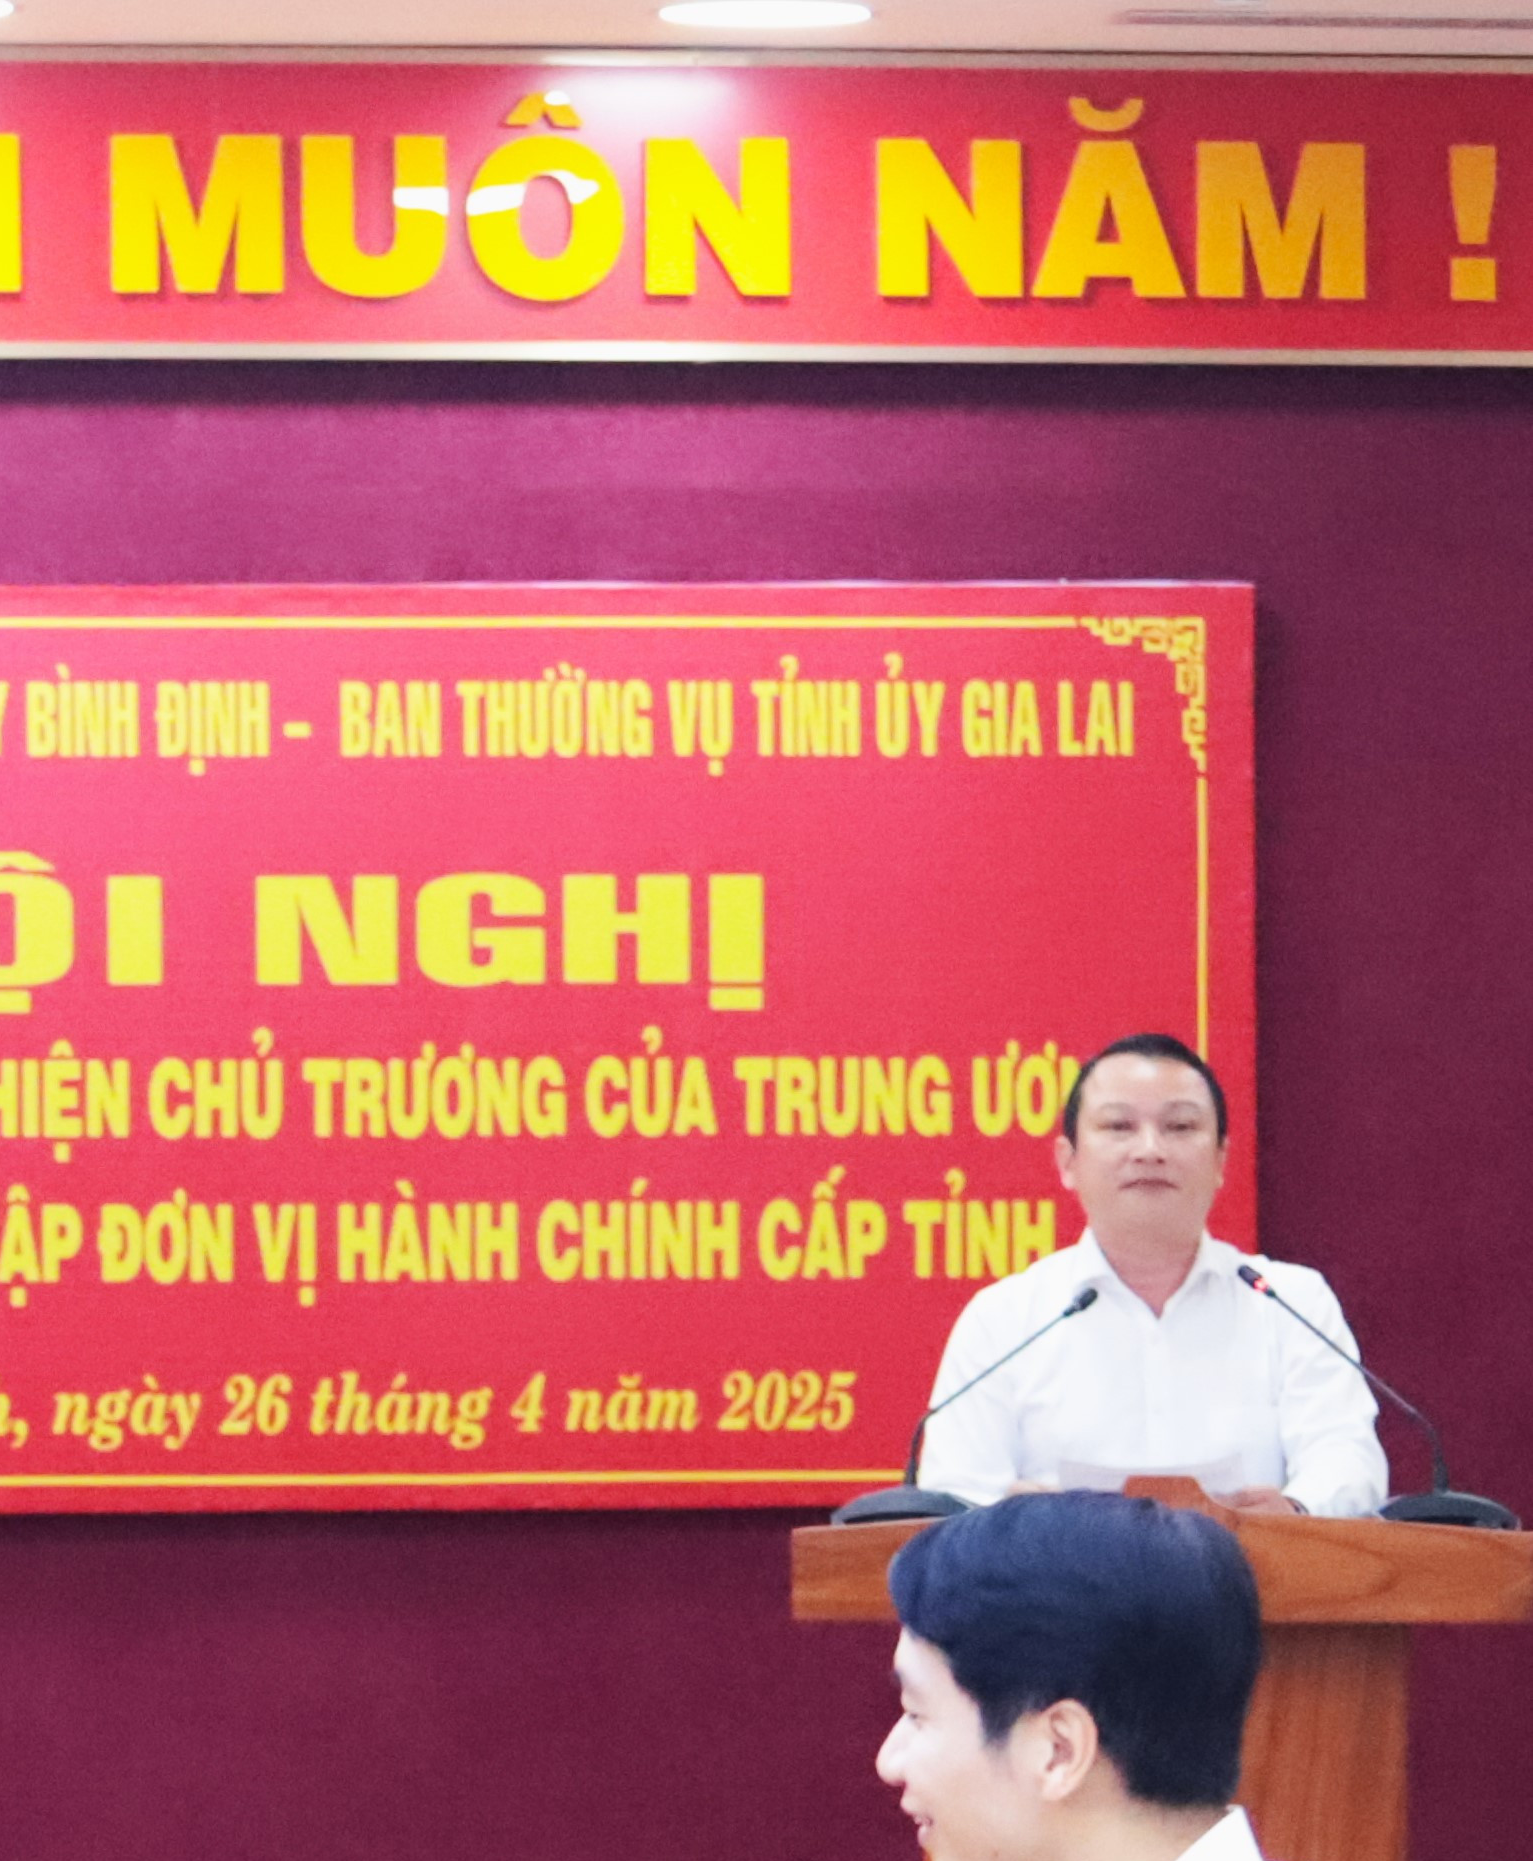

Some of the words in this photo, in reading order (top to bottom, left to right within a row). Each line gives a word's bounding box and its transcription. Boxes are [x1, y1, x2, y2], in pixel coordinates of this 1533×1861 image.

[109, 90, 793, 302] MUÔN
[876, 97, 1366, 299] NĂM
[1449, 143, 1498, 301] !
[26, 663, 141, 757] BÌNH
[155, 681, 271, 775] ĐỊNH
[340, 680, 442, 757] BAN
[457, 662, 654, 758] THƯỜNG
[668, 680, 734, 776] VỤ
[751, 655, 862, 757] TỈNH
[875, 652, 946, 758] ỦY
[961, 679, 1043, 757] GIA
[1058, 680, 1135, 757] LAI
[255, 872, 765, 1011] NGHỊ
[148, 1026, 285, 1140] CHỦ
[302, 1042, 568, 1139] TRƯƠNG
[584, 1026, 718, 1138] CỦA
[734, 1054, 953, 1138] TRUNG
[972, 1039, 1082, 1138] ƯƠ
[97, 1189, 235, 1285] ĐƠN
[253, 1202, 318, 1307] VỊ
[337, 1180, 520, 1282] HÀNH
[537, 1179, 741, 1282] CHÍNH
[757, 1165, 889, 1281] CẤP
[903, 1168, 1056, 1280] TỈNH
[52, 1375, 202, 1452] ngày
[219, 1374, 293, 1437] 26
[309, 1371, 494, 1451] tháng
[511, 1373, 546, 1433] 4
[566, 1375, 698, 1433] năm
[717, 1370, 857, 1432] 2025
